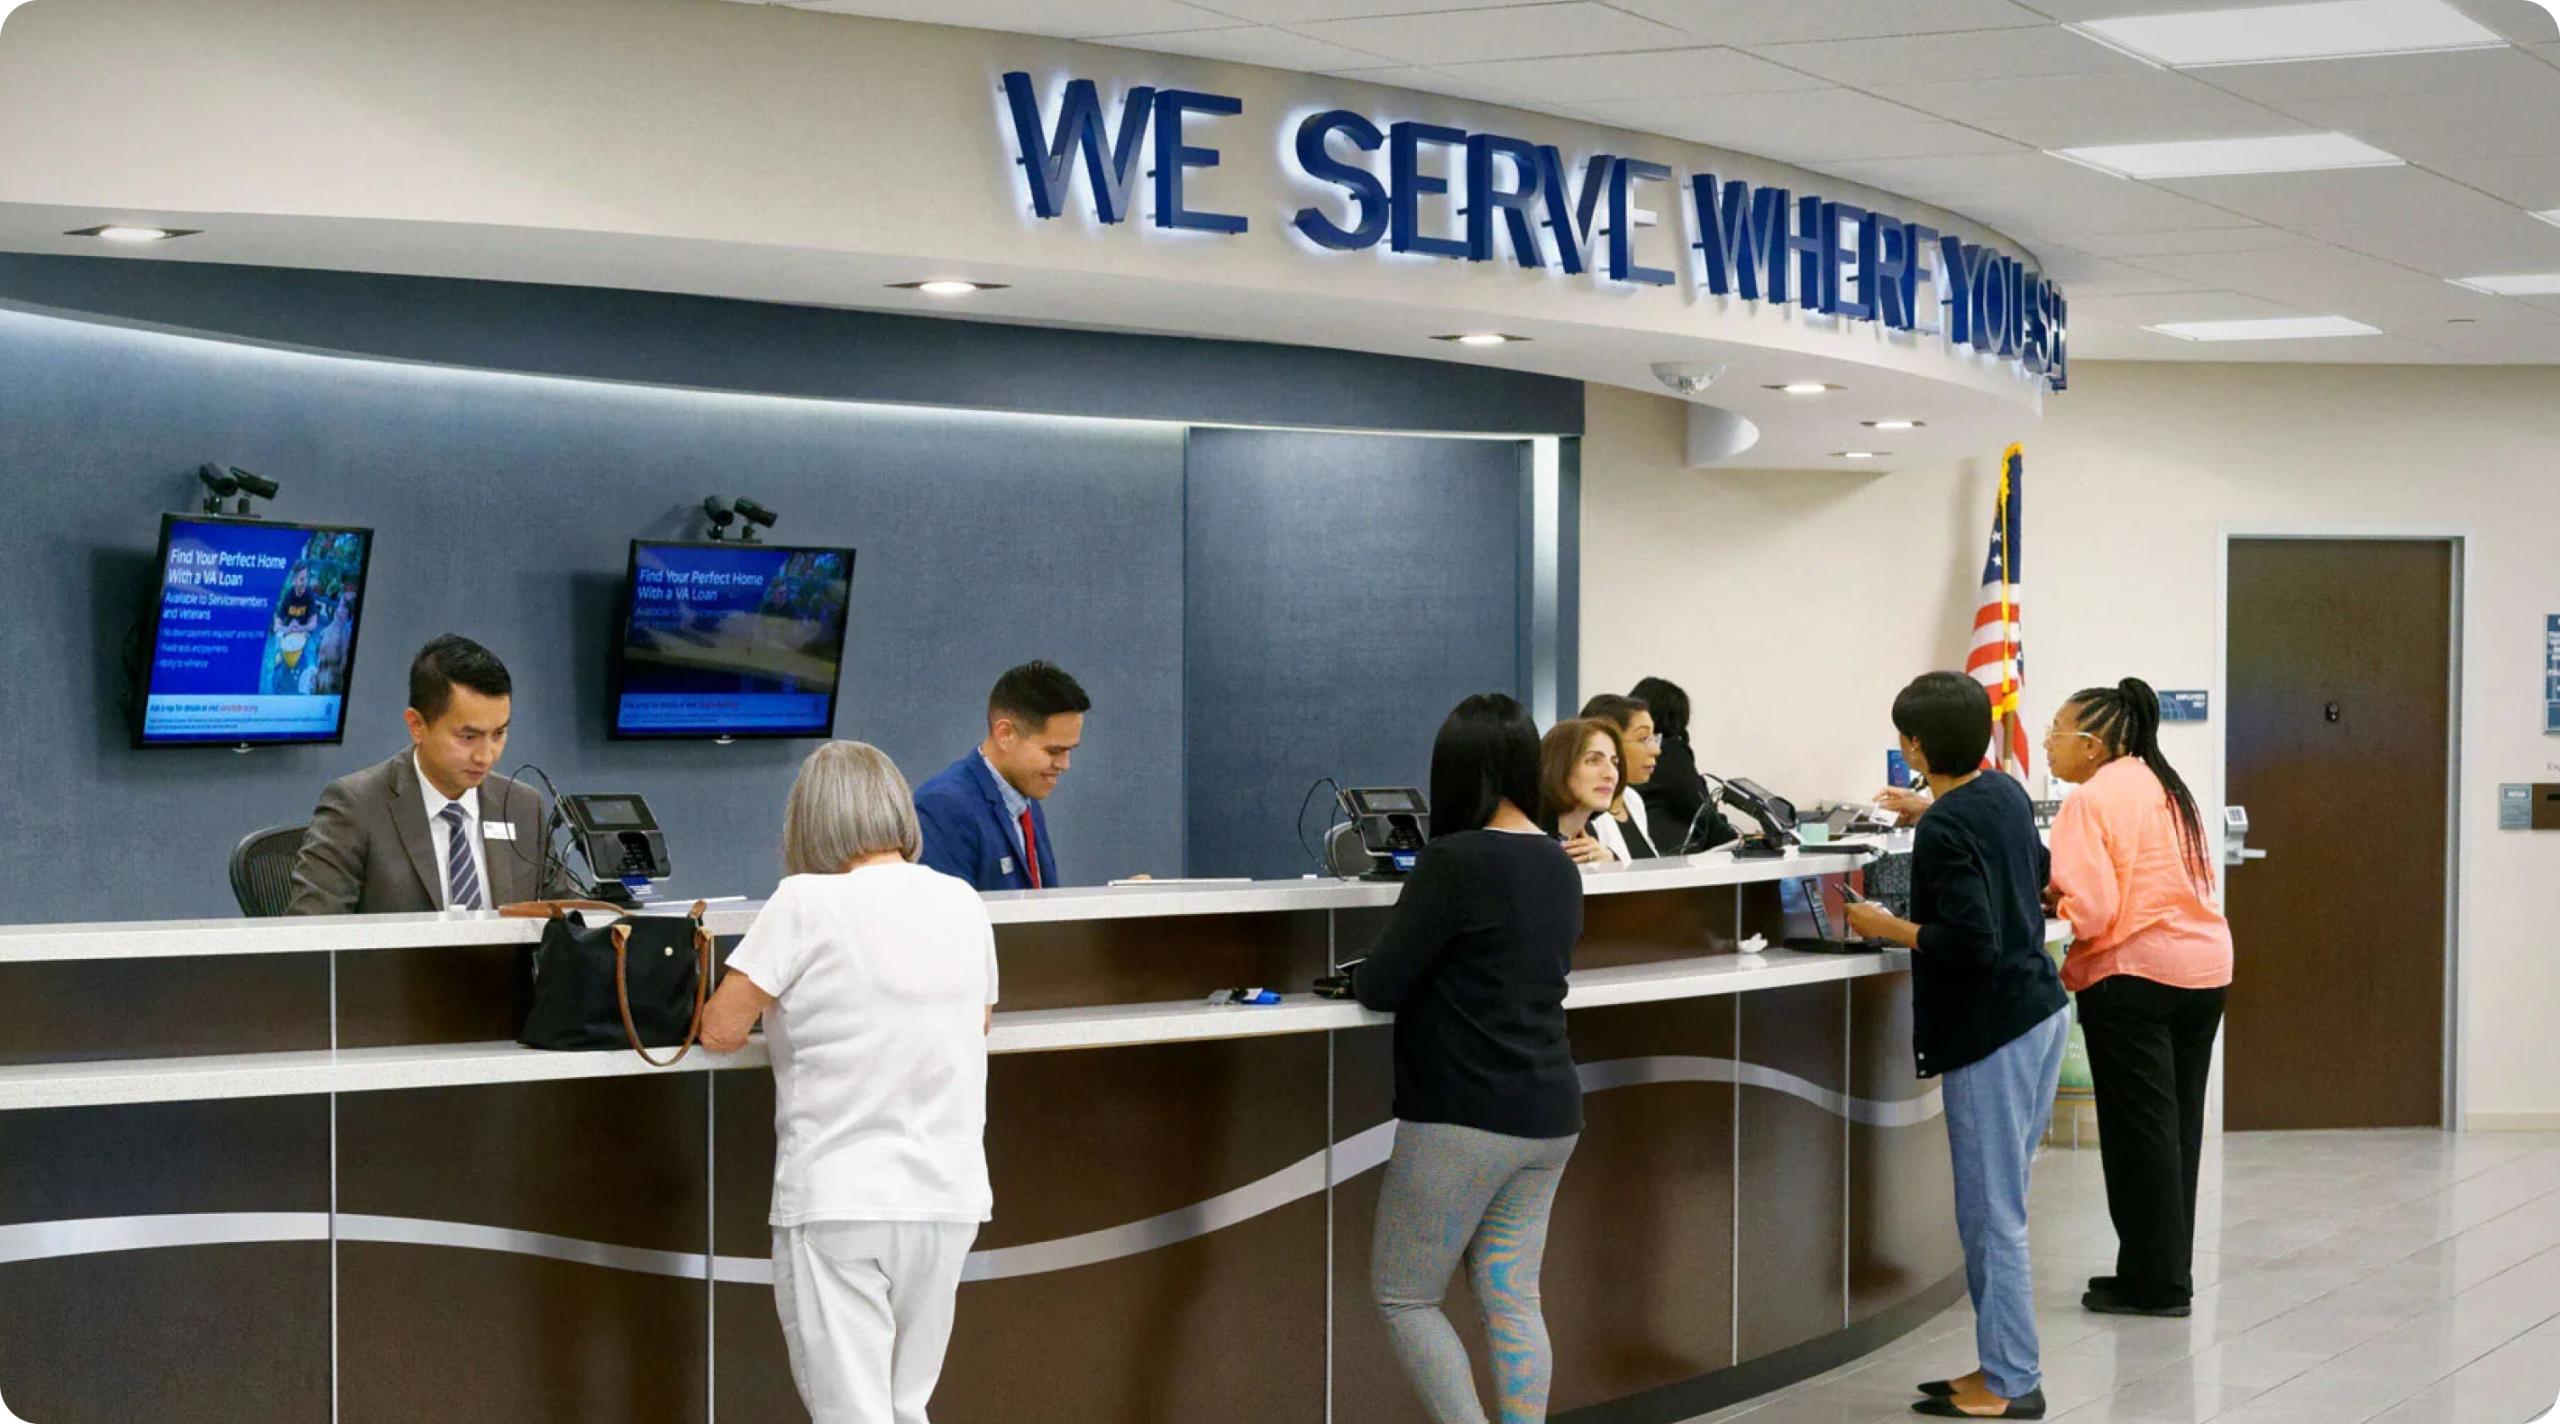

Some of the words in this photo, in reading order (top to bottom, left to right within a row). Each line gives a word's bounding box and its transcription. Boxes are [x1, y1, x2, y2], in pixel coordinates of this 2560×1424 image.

[1002, 70, 1249, 235] WE
[1294, 108, 1676, 286] SERVE
[1692, 173, 1940, 335] WHERE
[1940, 236, 2024, 361] YOU
[171, 548, 193, 564] Find
[196, 550, 218, 565] Your
[219, 551, 256, 568] Perfect
[257, 554, 286, 569] Home
[168, 568, 192, 584] With
[194, 573, 201, 585] a
[203, 570, 216, 585] VA
[219, 571, 243, 586] Loan
[640, 568, 663, 583] Find
[666, 569, 690, 584] Your
[691, 570, 731, 585] Perfect
[732, 572, 763, 586] Home
[638, 585, 663, 599] With
[665, 589, 673, 600] a
[675, 587, 689, 600] VA
[692, 588, 718, 601] Loan
